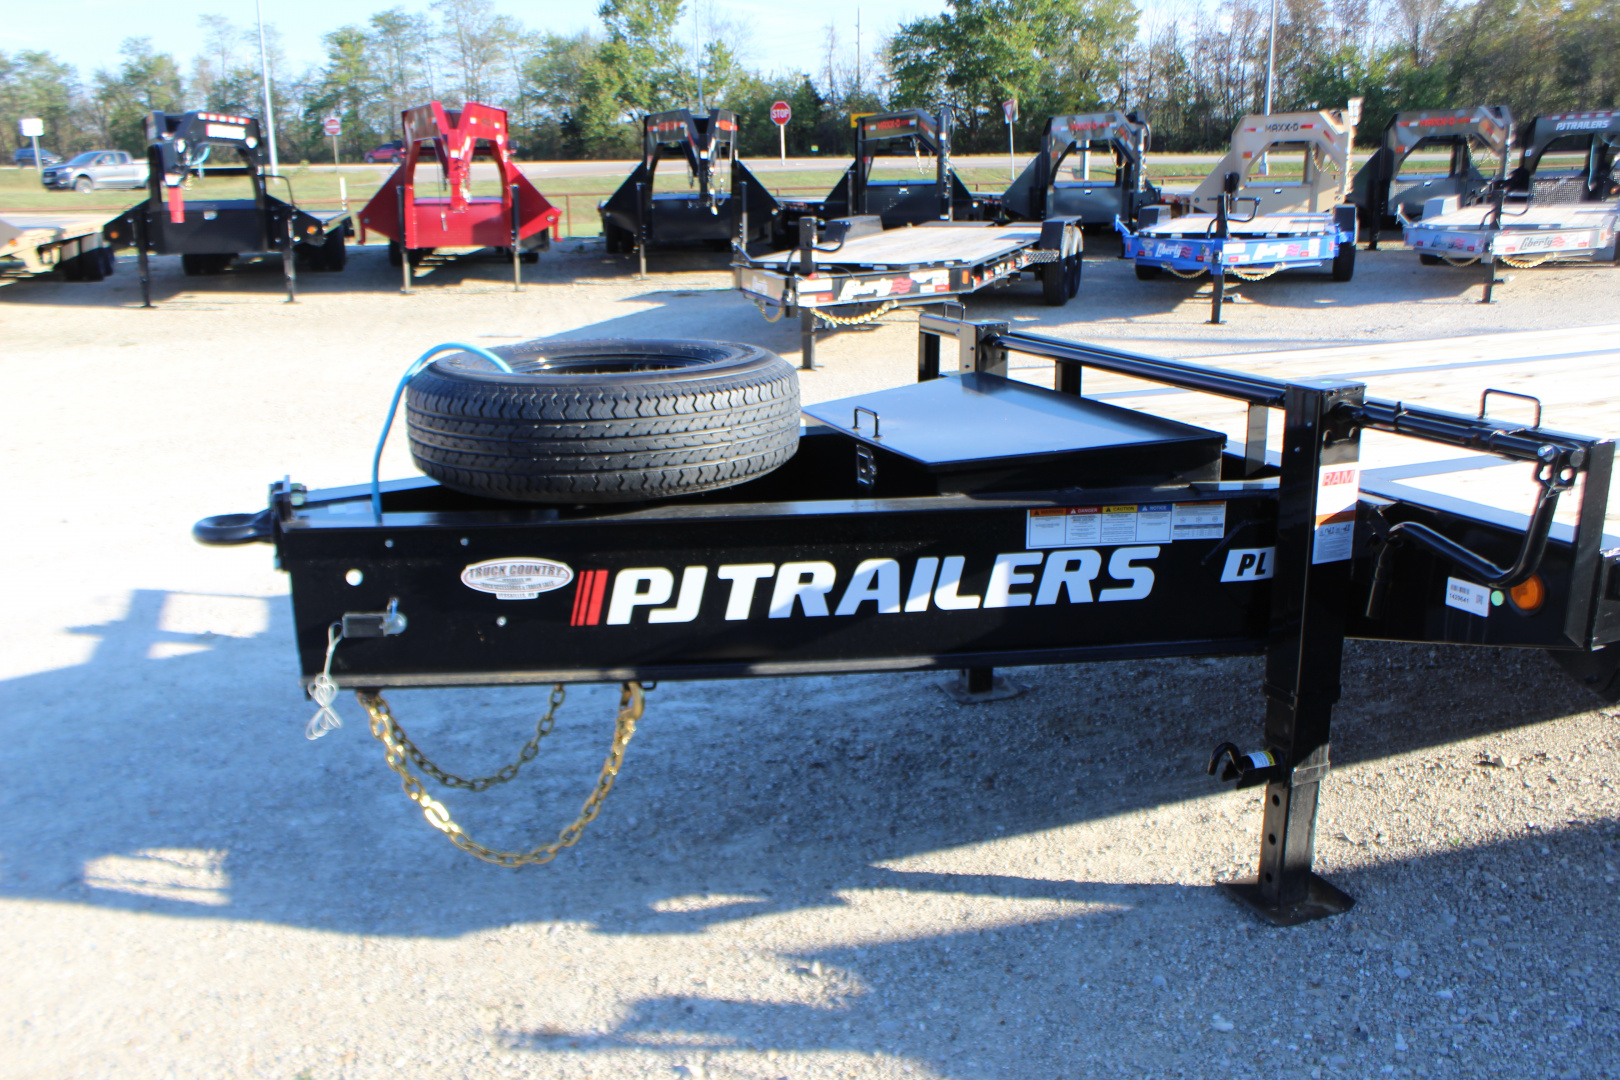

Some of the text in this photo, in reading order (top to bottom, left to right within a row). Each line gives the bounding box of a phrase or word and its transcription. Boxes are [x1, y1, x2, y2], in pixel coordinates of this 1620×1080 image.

[772, 109, 790, 119] STOP
[1264, 122, 1299, 133] MAXX-D
[1519, 237, 1554, 251] Liberty
[1323, 470, 1355, 486] RAM
[469, 564, 564, 579] TRUCK COUNTRY
